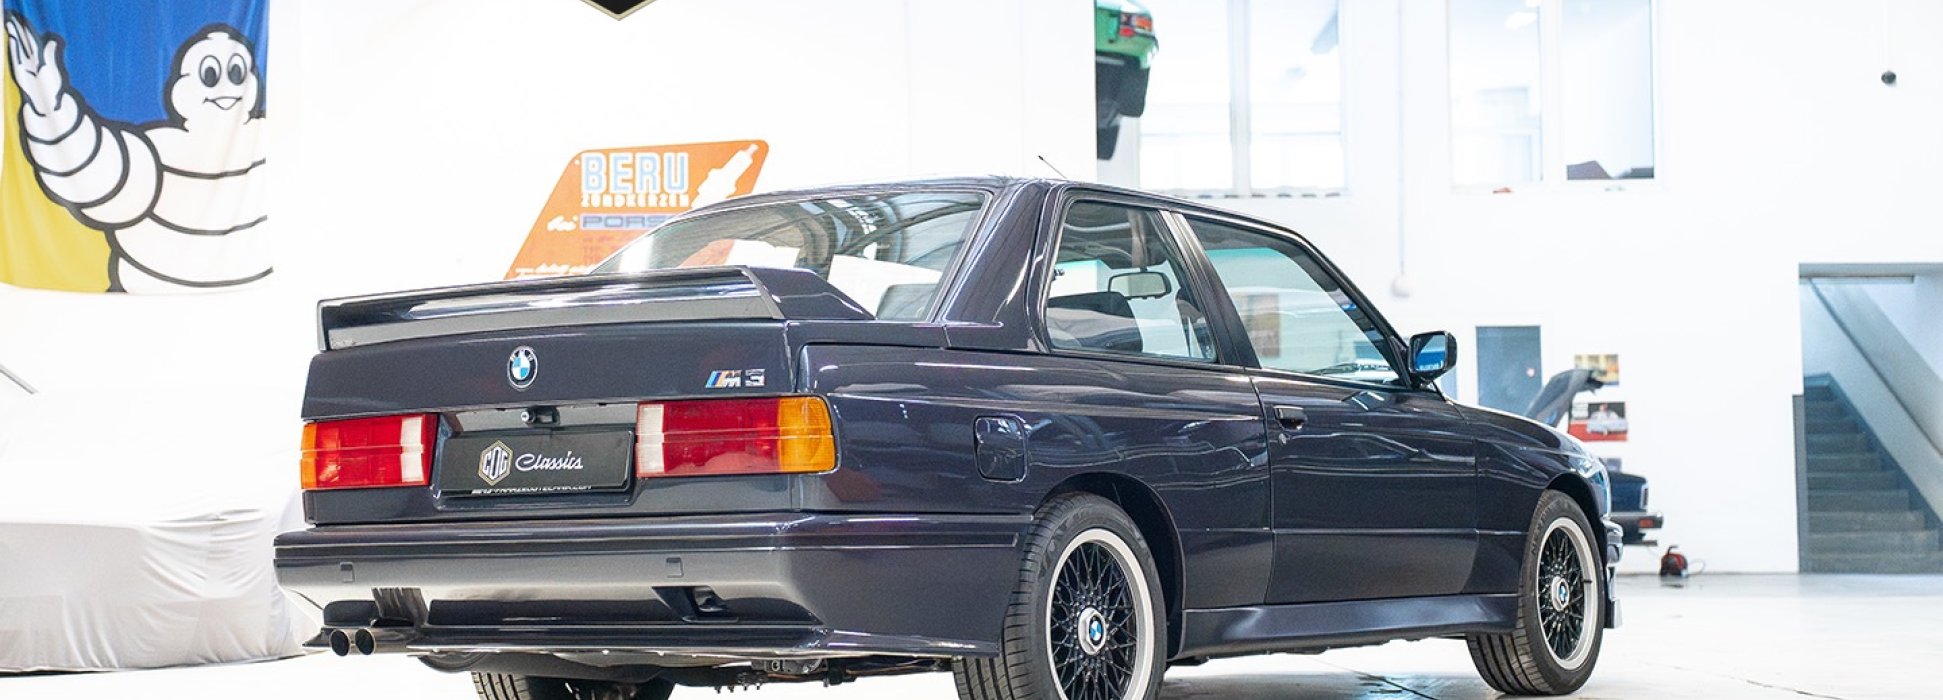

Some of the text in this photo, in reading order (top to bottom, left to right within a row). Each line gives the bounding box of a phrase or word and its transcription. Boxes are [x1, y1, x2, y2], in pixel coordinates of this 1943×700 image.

[582, 152, 689, 194] BERU
[482, 446, 583, 480] COG Classics
